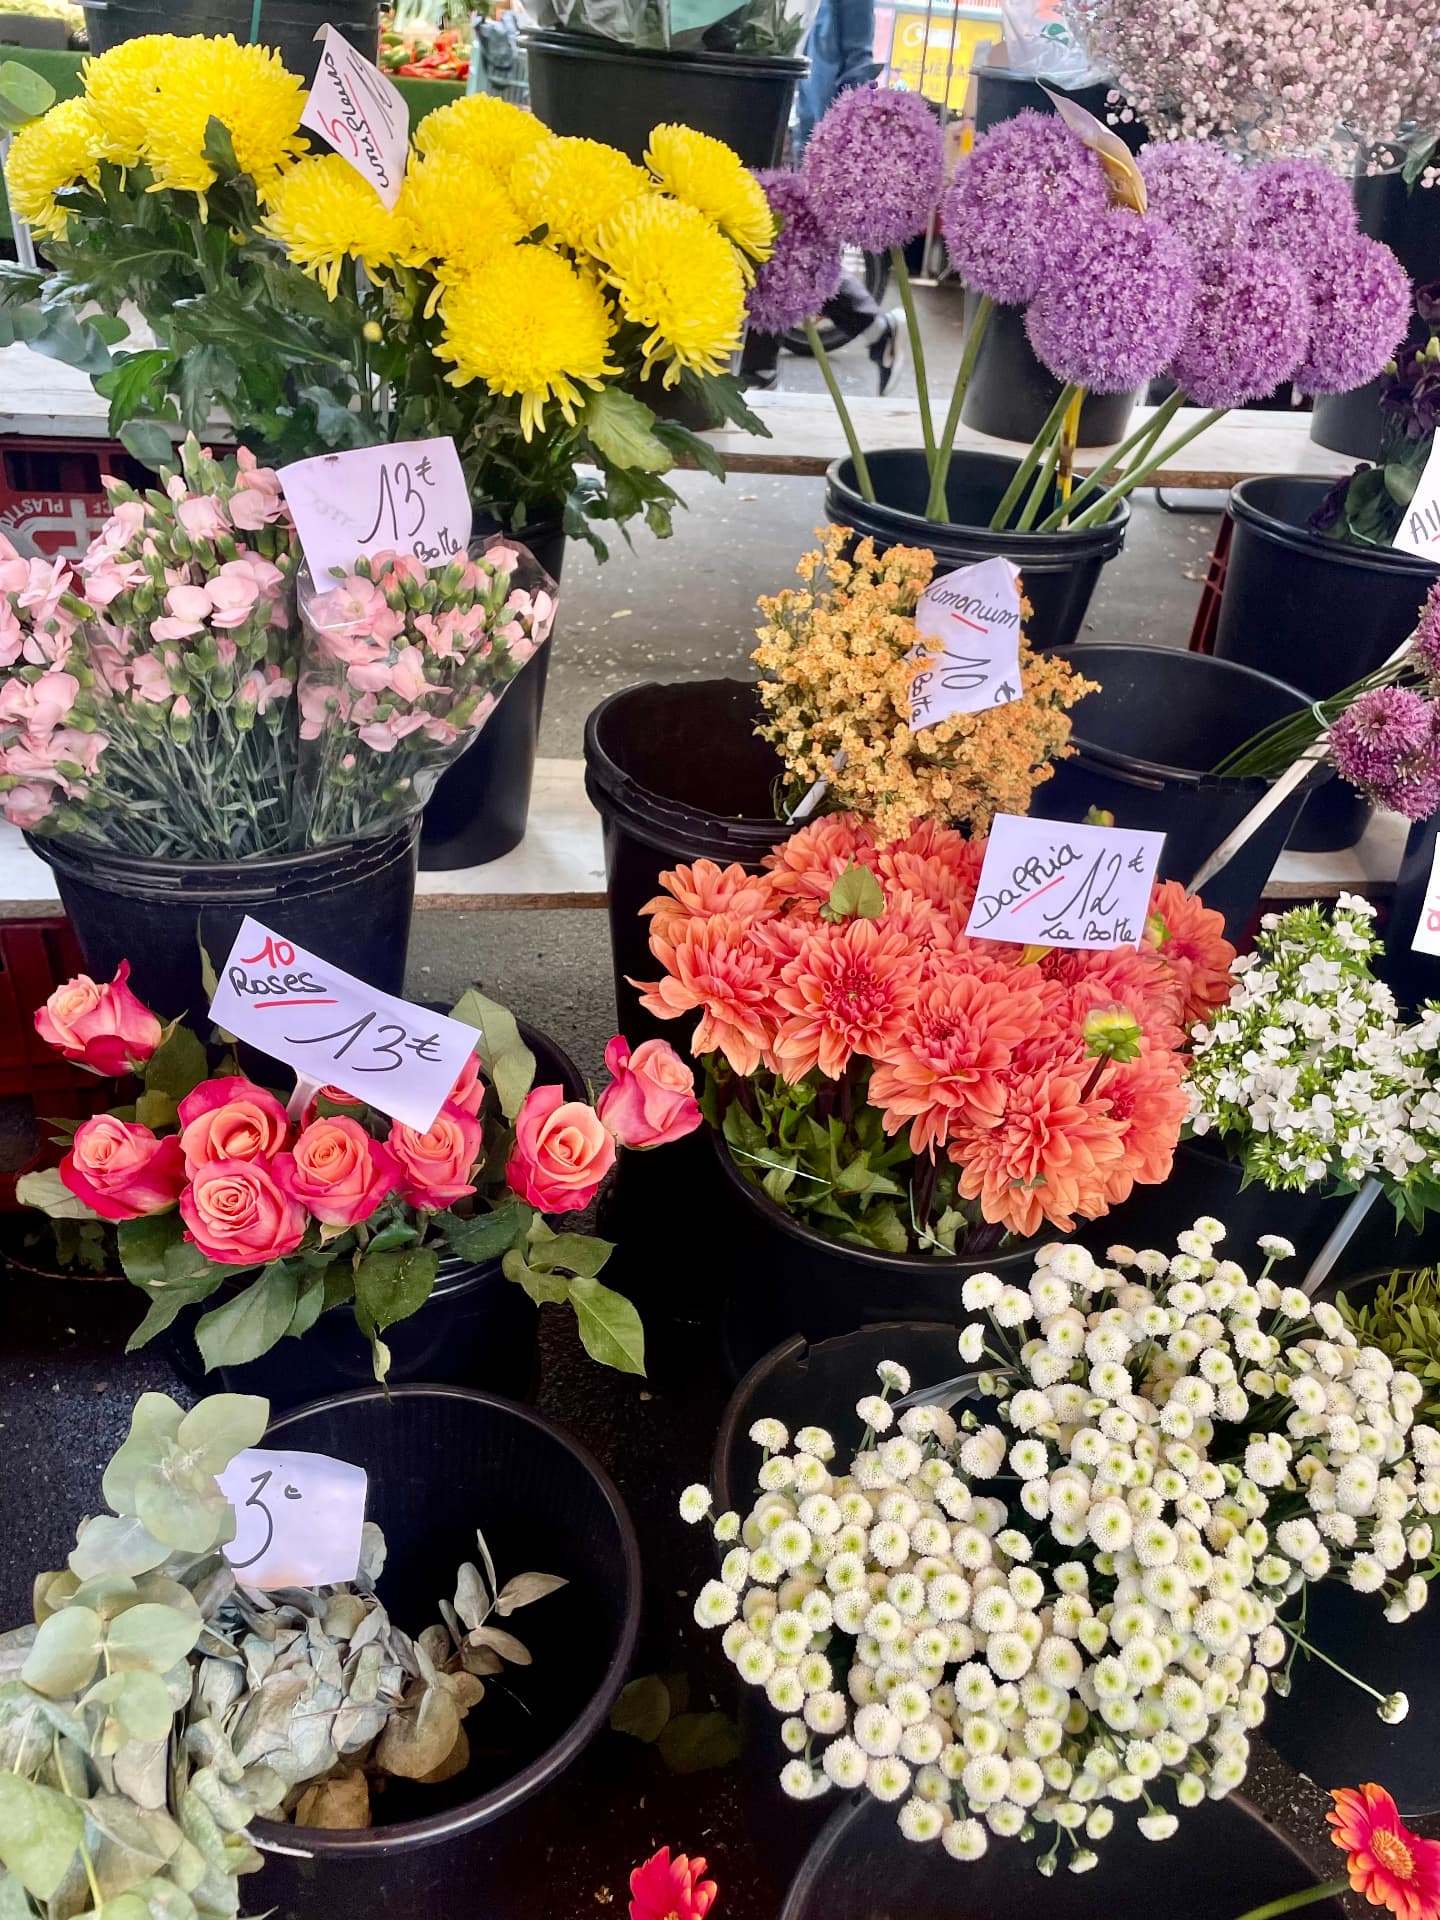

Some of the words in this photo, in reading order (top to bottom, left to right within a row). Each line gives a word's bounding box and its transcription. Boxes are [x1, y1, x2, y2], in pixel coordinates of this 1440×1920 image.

[317, 110, 359, 157] 5
[1039, 921, 1075, 941] La
[240, 935, 296, 969] 10
[228, 966, 328, 997] Roses
[283, 1010, 443, 1073] 13€
